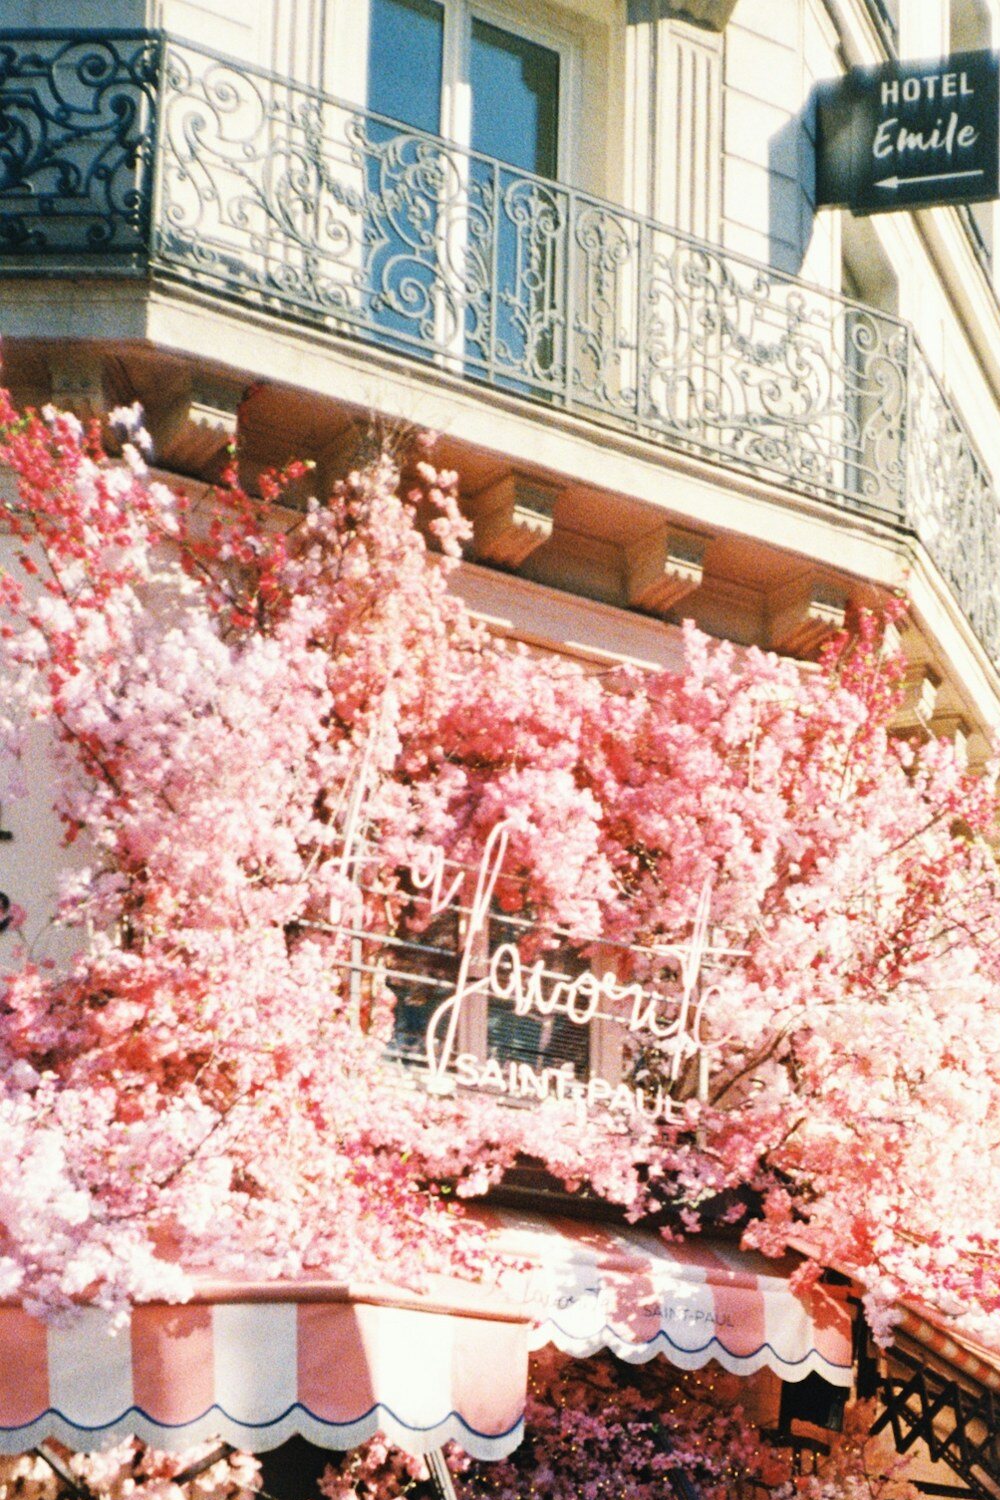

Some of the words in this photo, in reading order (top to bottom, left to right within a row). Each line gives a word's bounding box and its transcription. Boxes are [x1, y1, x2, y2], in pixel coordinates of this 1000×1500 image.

[881, 72, 974, 104] HOTEL
[873, 111, 980, 159] Emile
[453, 1053, 689, 1126] SAINT-PAUL
